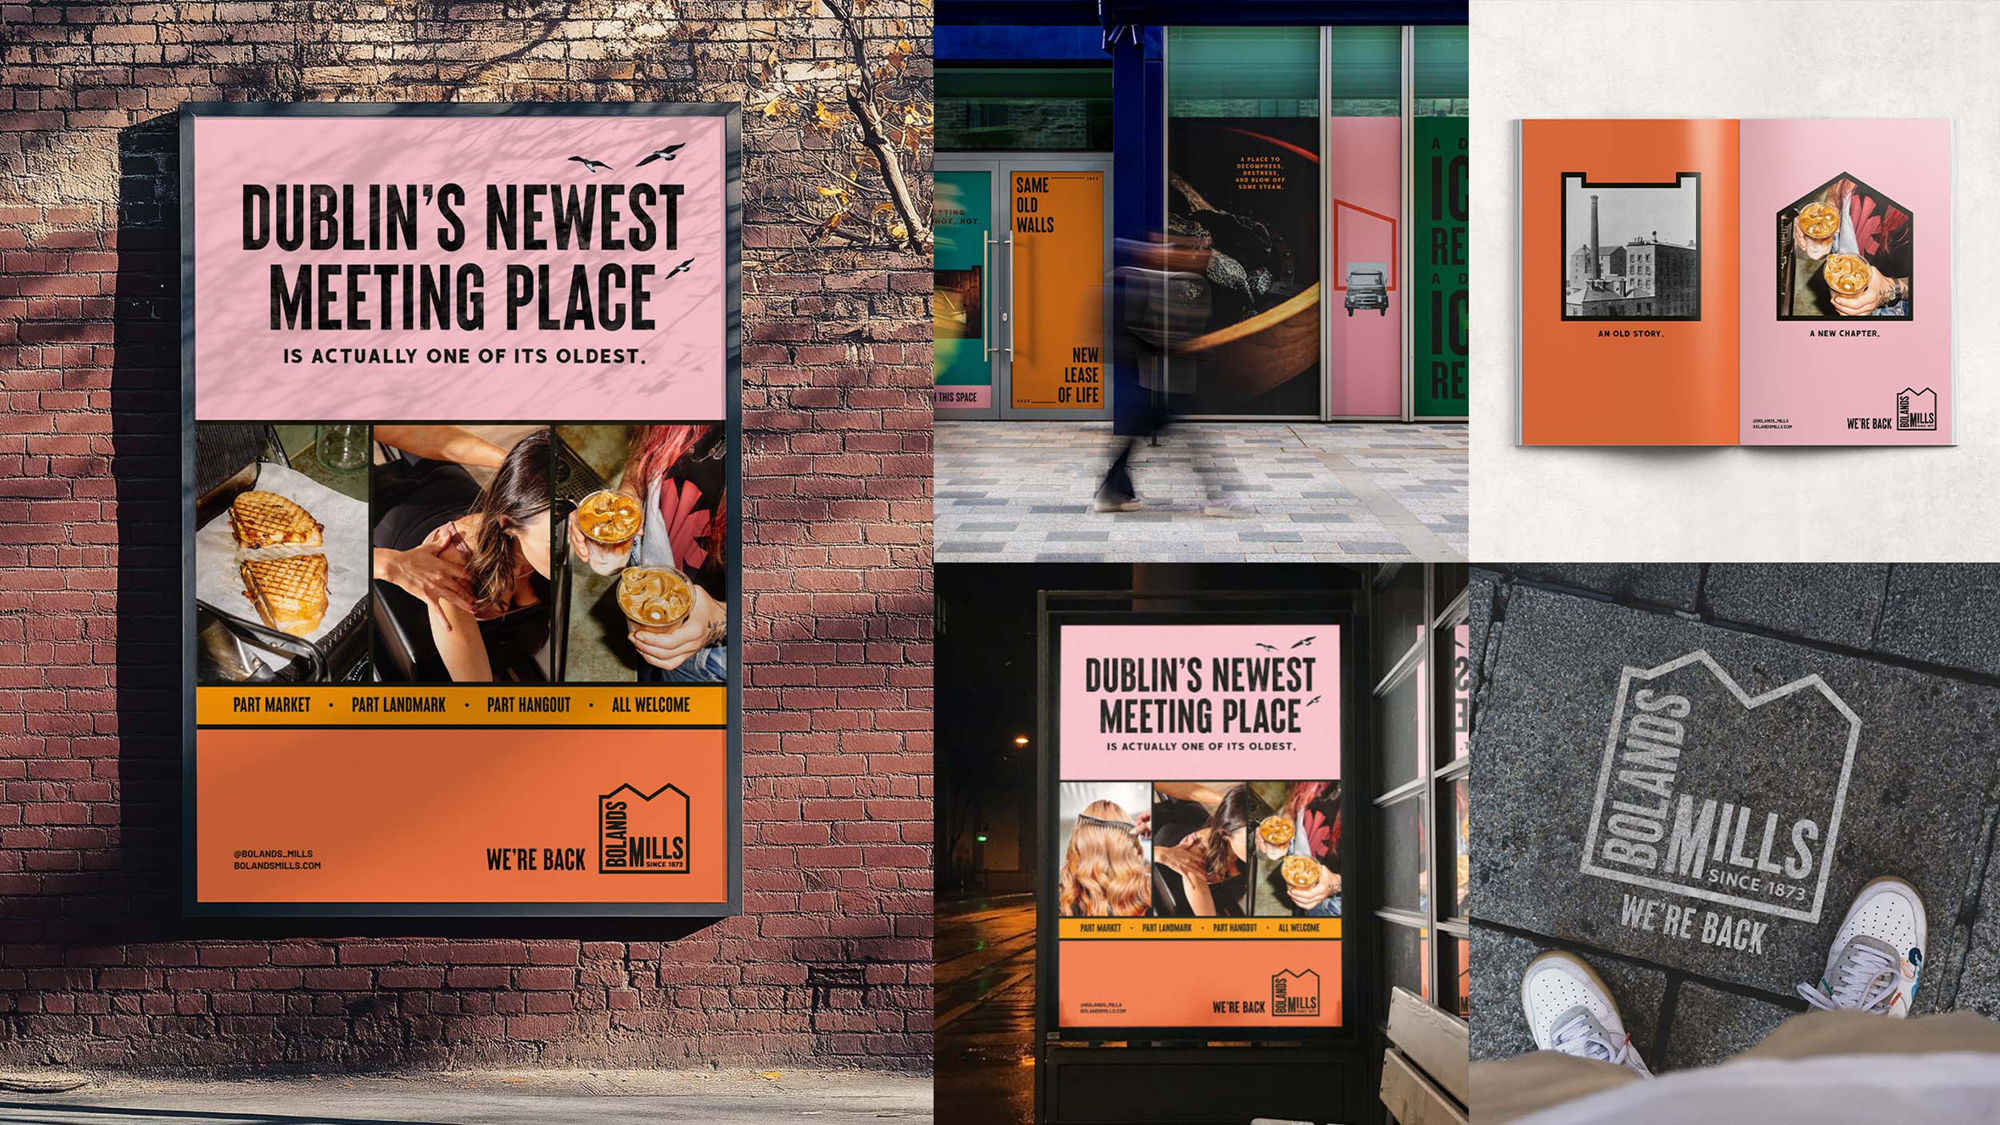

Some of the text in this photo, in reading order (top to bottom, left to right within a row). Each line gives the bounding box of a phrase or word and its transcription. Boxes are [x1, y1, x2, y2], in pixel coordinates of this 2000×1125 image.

[1431, 138, 1440, 150] A
[1016, 177, 1049, 193] SAME
[1016, 197, 1038, 213] OLD
[242, 182, 685, 251] DUBLIN'S NEWEST
[1016, 217, 1054, 233] WALLS
[1432, 272, 1440, 284] A
[270, 262, 656, 331] MEETING PLACE
[1598, 330, 1665, 338] AN OLD STORY.
[1809, 330, 1880, 338] A NEW CHAPTER.
[283, 347, 646, 365] IS ACTUALLY ONE OF ITS OLDEST.
[1073, 347, 1099, 363] NEW
[1065, 367, 1099, 383] LEASE
[939, 392, 954, 402] THIS
[956, 392, 977, 402] SPACE
[1058, 387, 1099, 403] OF LIFE
[1900, 396, 1909, 427] BOLANDS
[1910, 412, 1934, 427] MILLS
[1847, 417, 1892, 429] WE'RE BACK
[1086, 657, 1316, 693] DUBLIN'S NEWEST
[233, 696, 690, 712] PART MARKET PART LANDMARK PART HANGOUT ALL WELCOME
[1100, 698, 1302, 734] MEETING PLACE
[1107, 742, 1297, 751] IS ACTUALLY ONE OF ITS OLDEST.
[1601, 688, 1691, 870] BOLANDS
[605, 801, 627, 867] BOLANDS
[1664, 794, 1819, 880] MILLS
[234, 850, 313, 858] @BOLANDS_MILLS
[486, 848, 586, 870] WE'RE BACK
[629, 836, 684, 867] MILLS
[1708, 868, 1806, 902] SINCE 1873
[1080, 923, 1320, 932] PART MARKET PART LANDMARK PART HANGOUT ALL WELCOME
[1621, 894, 1768, 955] WE'RE BACK
[1275, 978, 1287, 1013] BOLANDS
[1213, 1001, 1265, 1013] WE'RE BACK
[1288, 996, 1317, 1013] MILLS
